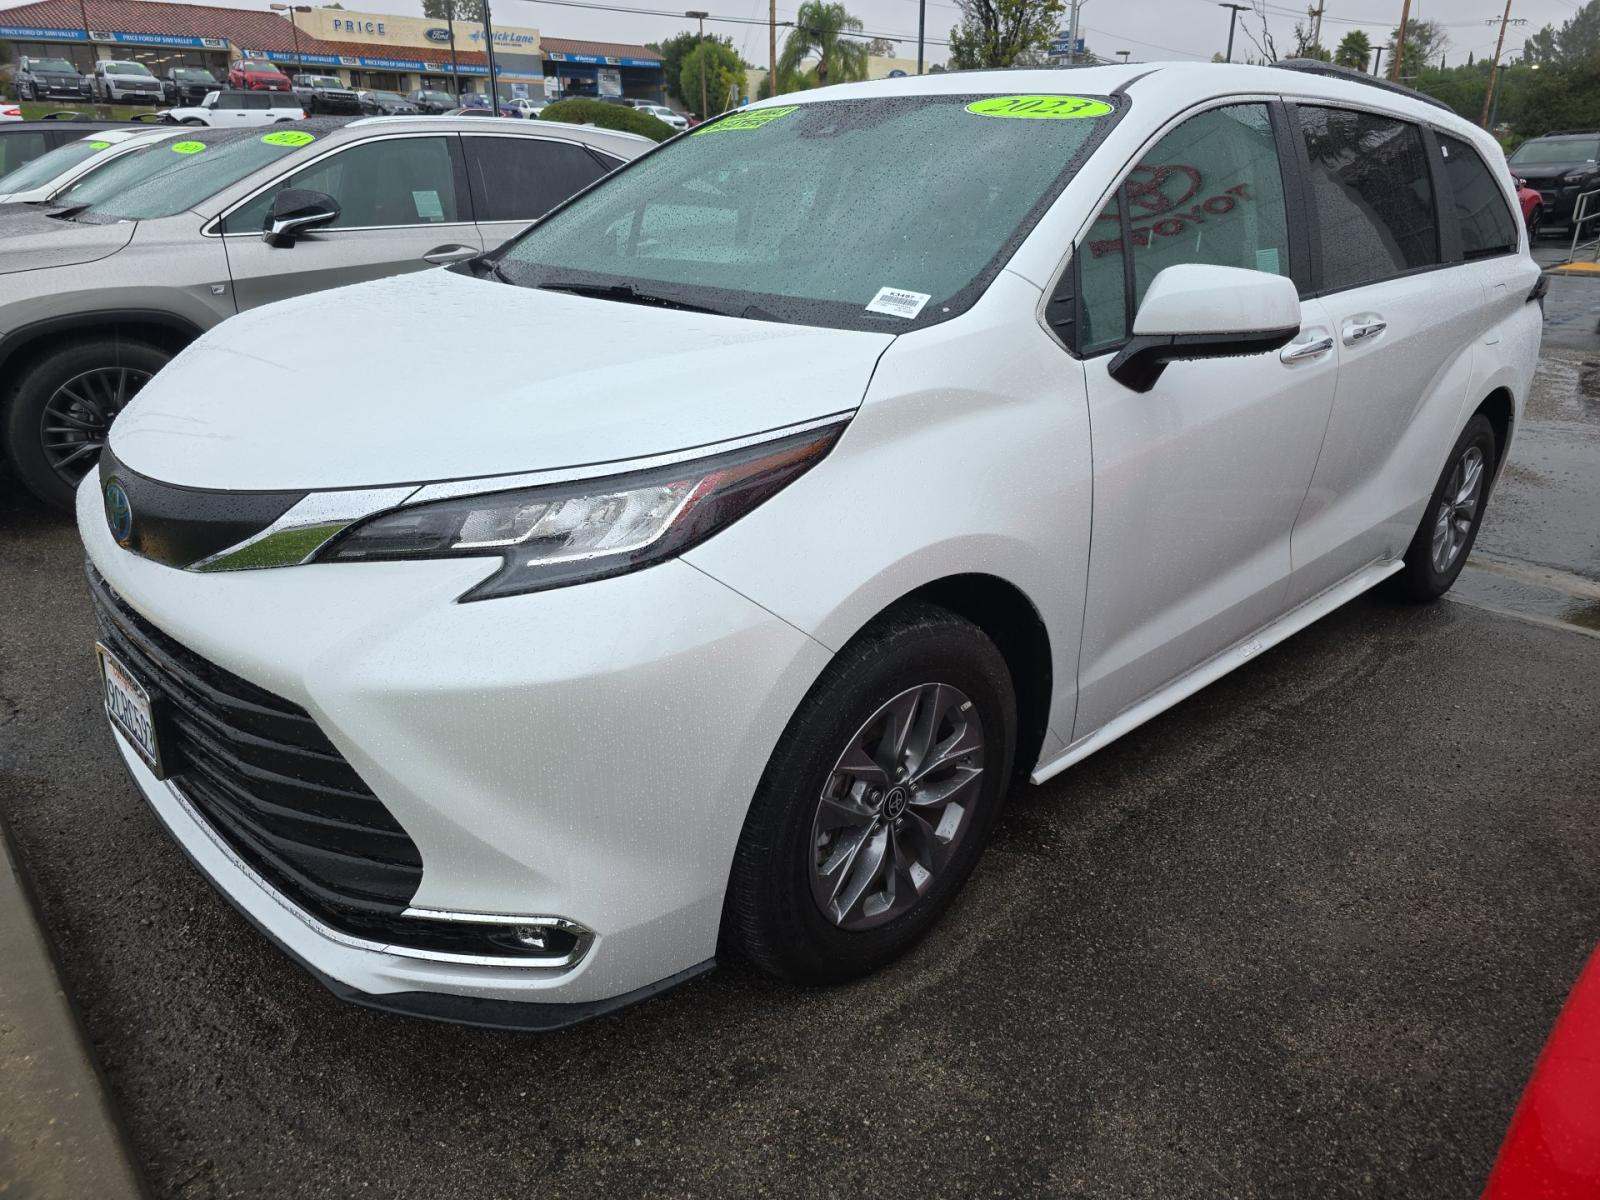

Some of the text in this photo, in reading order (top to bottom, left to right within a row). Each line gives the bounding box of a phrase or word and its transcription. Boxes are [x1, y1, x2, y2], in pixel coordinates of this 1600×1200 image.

[334, 19, 386, 36] PRICE
[58, 31, 79, 39] VALLEY
[511, 32, 534, 44] Lane
[983, 99, 1093, 115] 2023
